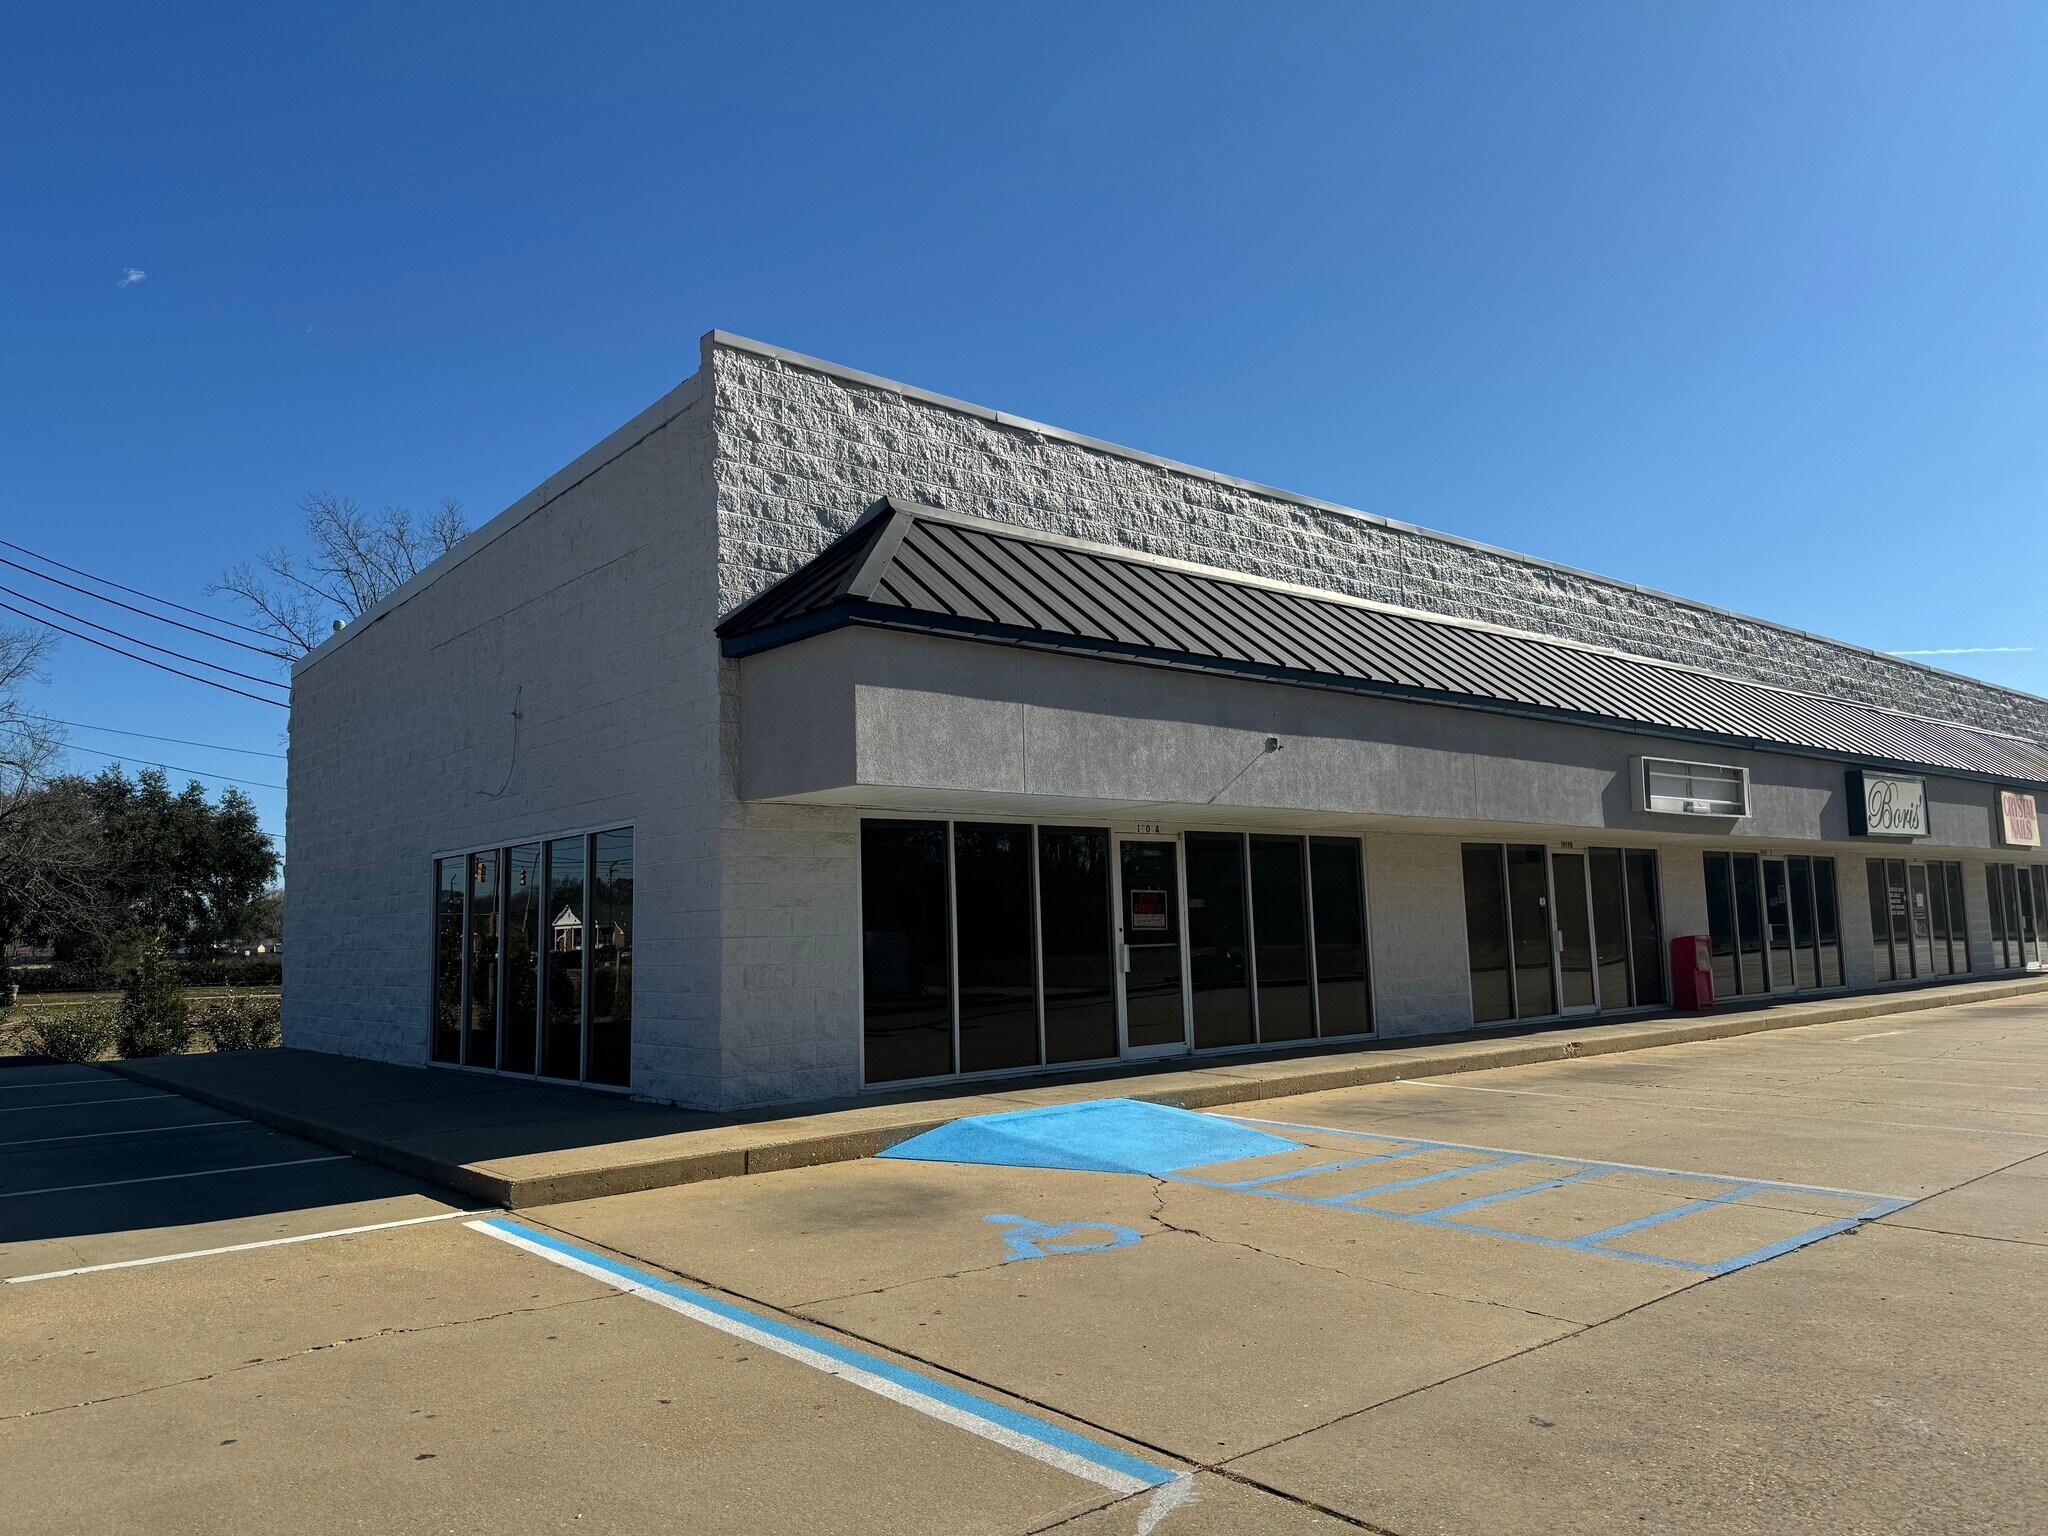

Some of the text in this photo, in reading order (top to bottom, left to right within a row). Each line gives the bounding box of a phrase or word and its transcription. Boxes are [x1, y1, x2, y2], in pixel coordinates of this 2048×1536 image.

[2003, 796, 2035, 819] CRYSTAL
[2010, 819, 2033, 840] NAILS
[1139, 894, 1158, 903] FOR
[1134, 904, 1164, 914] RENT
